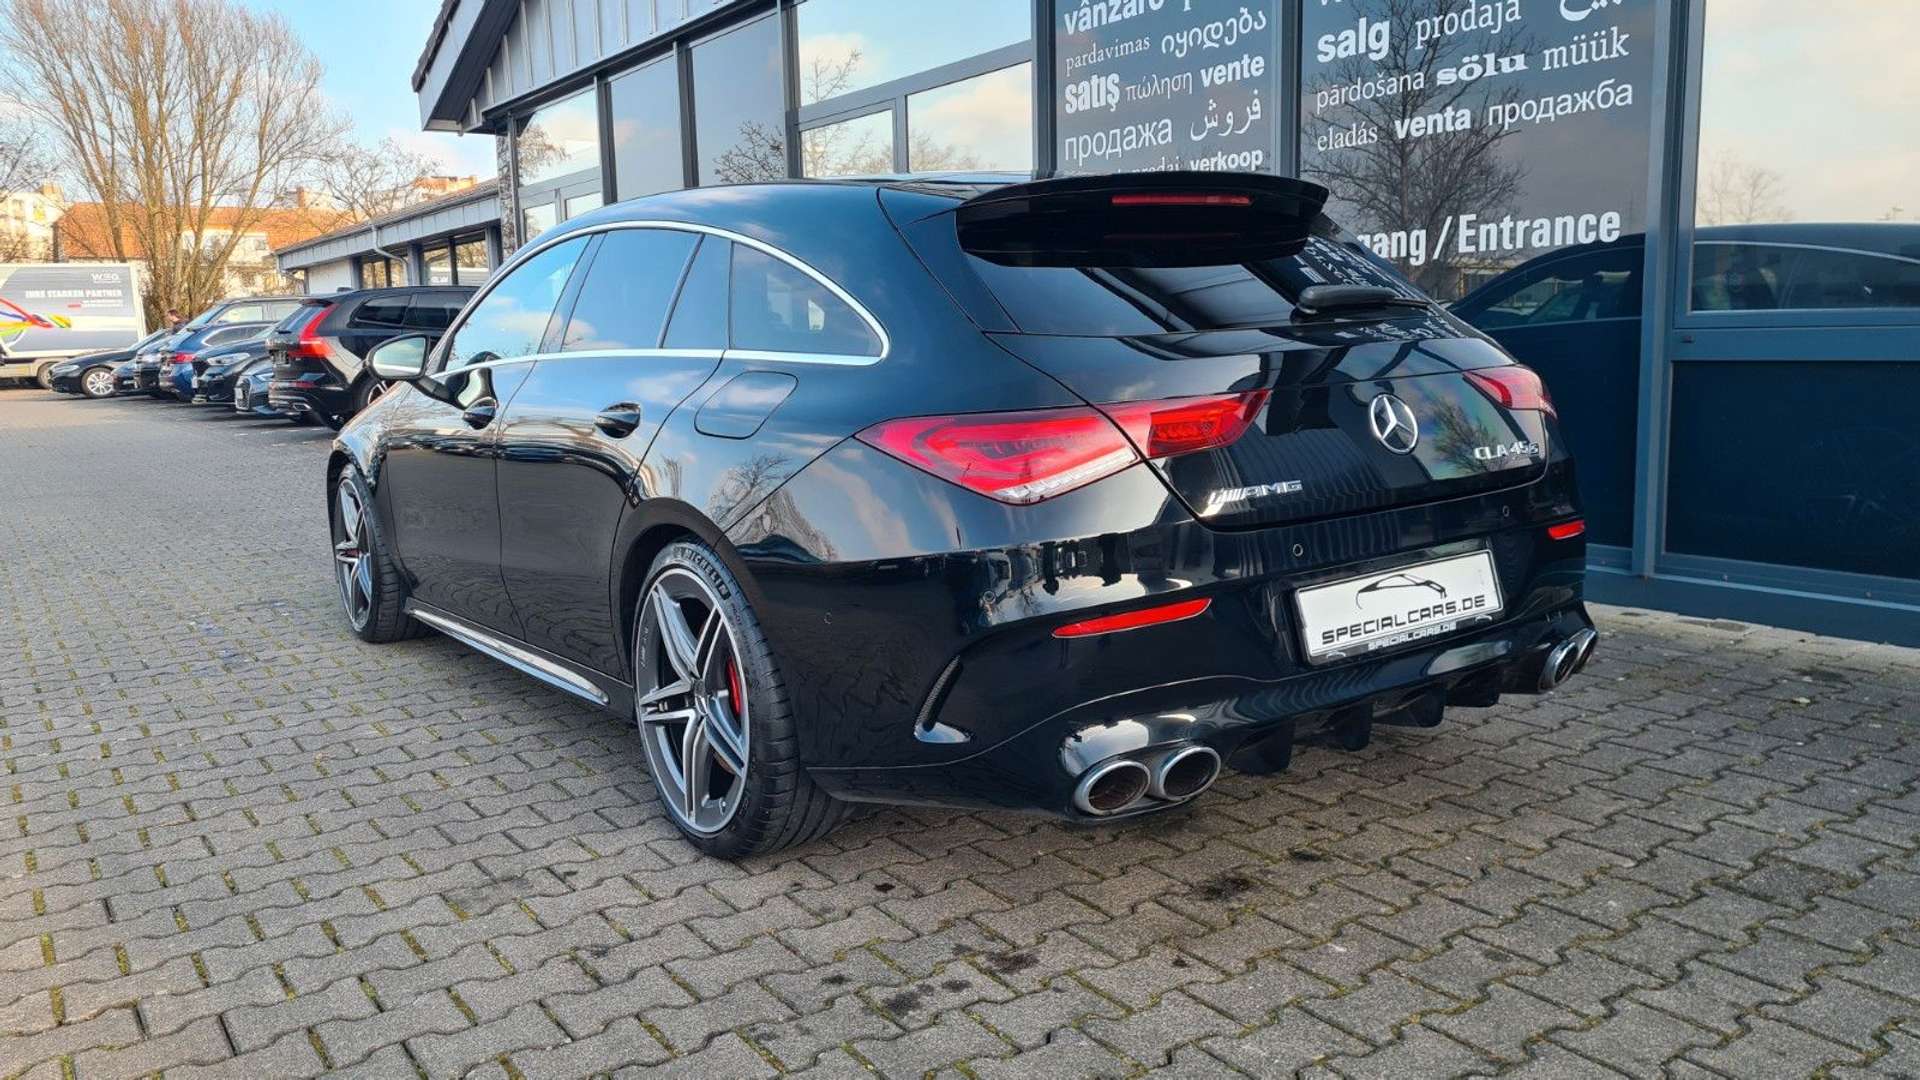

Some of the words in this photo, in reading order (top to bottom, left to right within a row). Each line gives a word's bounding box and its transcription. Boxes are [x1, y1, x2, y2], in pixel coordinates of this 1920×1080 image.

[1065, 35, 1151, 76] pardavimas
[1317, 17, 1390, 63] salg
[1415, 0, 1521, 50] prodaja
[1200, 54, 1265, 88] vente
[1316, 69, 1425, 114] pārdošana
[1436, 52, 1528, 86] sölu
[1542, 26, 1630, 71] müük
[1317, 121, 1379, 151] eladás
[1395, 104, 1471, 139] venta
[1488, 78, 1633, 130] продажба
[1065, 118, 1172, 166] продажа
[1190, 149, 1264, 172] verkoop
[1458, 211, 1622, 253] Entrance
[1474, 444, 1508, 460] CLA
[683, 548, 730, 597] MICHELIN
[1322, 594, 1486, 645] SPECIALCARS.DE
